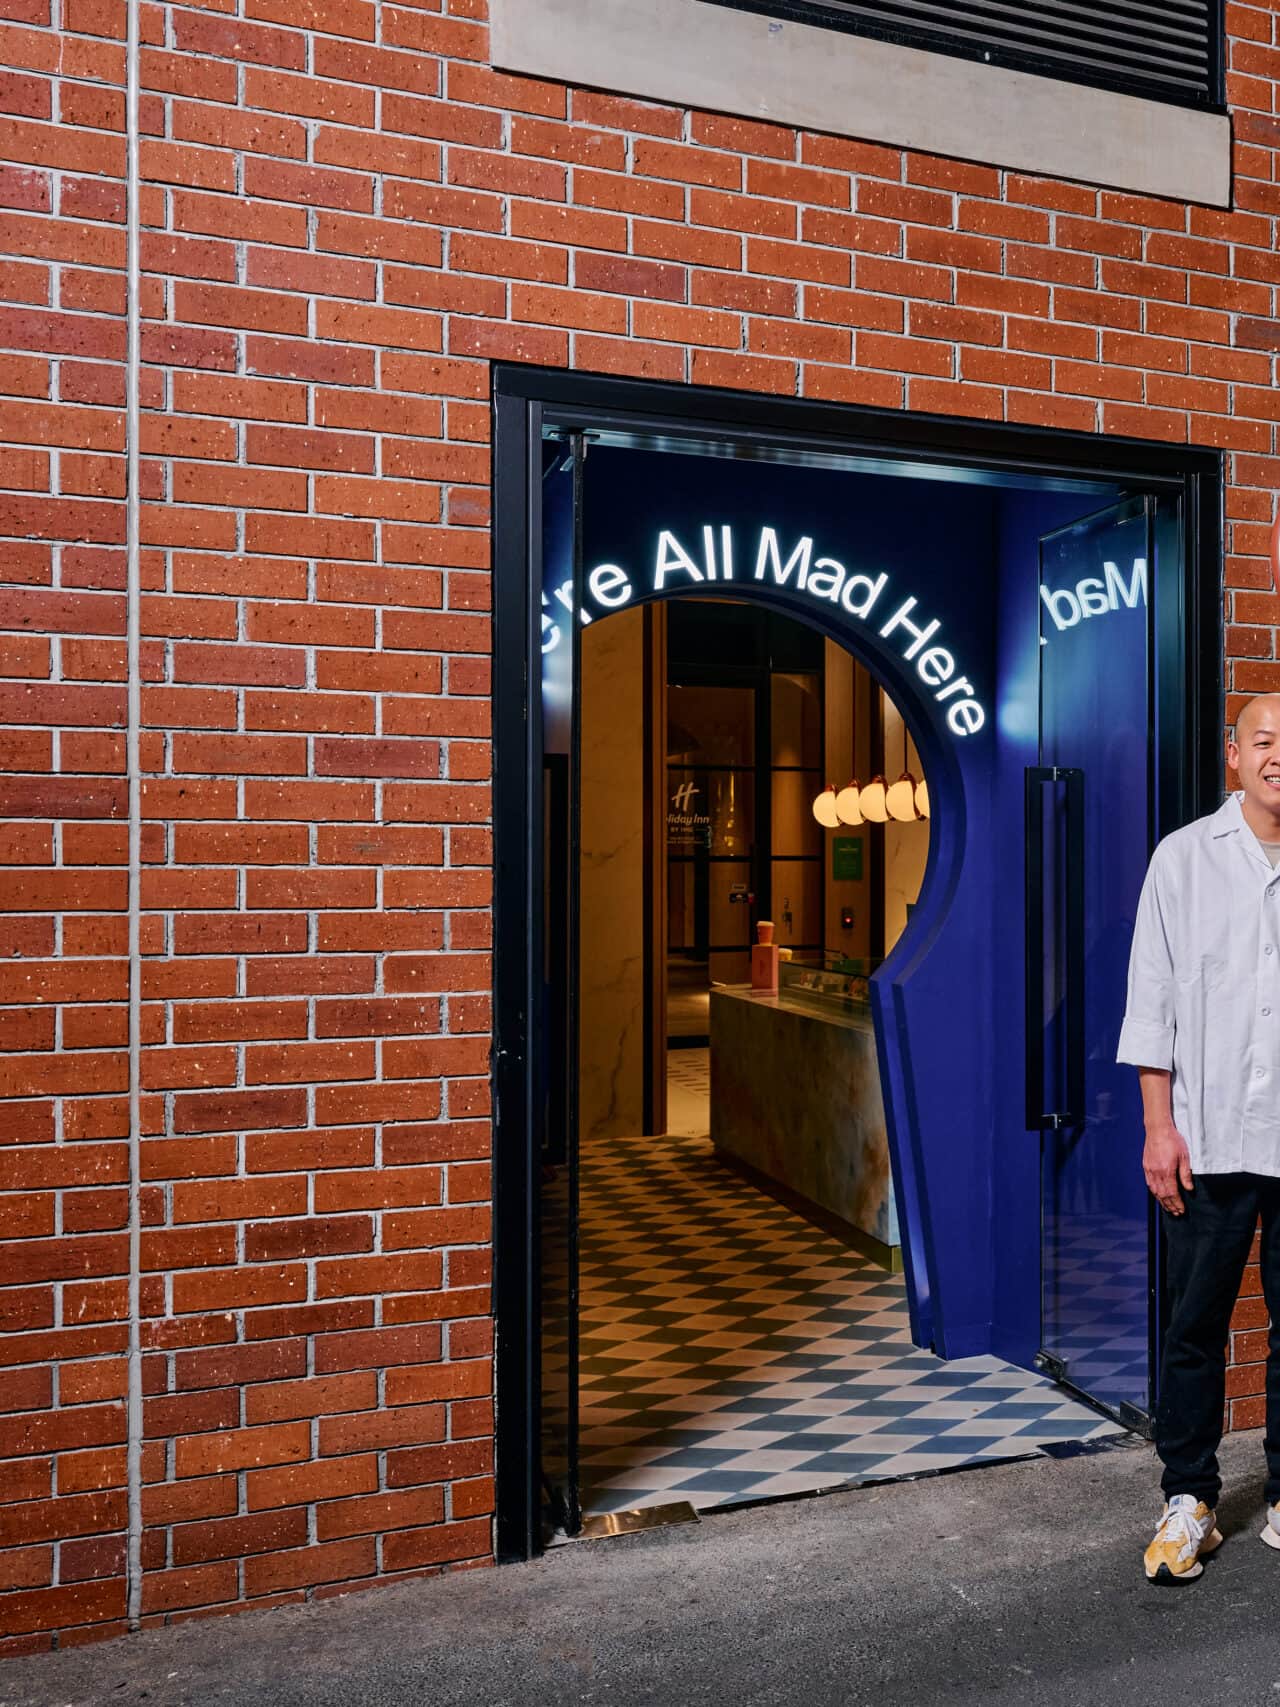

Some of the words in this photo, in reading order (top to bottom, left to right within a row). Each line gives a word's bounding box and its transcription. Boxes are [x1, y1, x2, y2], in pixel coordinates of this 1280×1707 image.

[654, 525, 735, 589] All
[755, 526, 888, 619] Mad
[879, 596, 985, 736] Here
